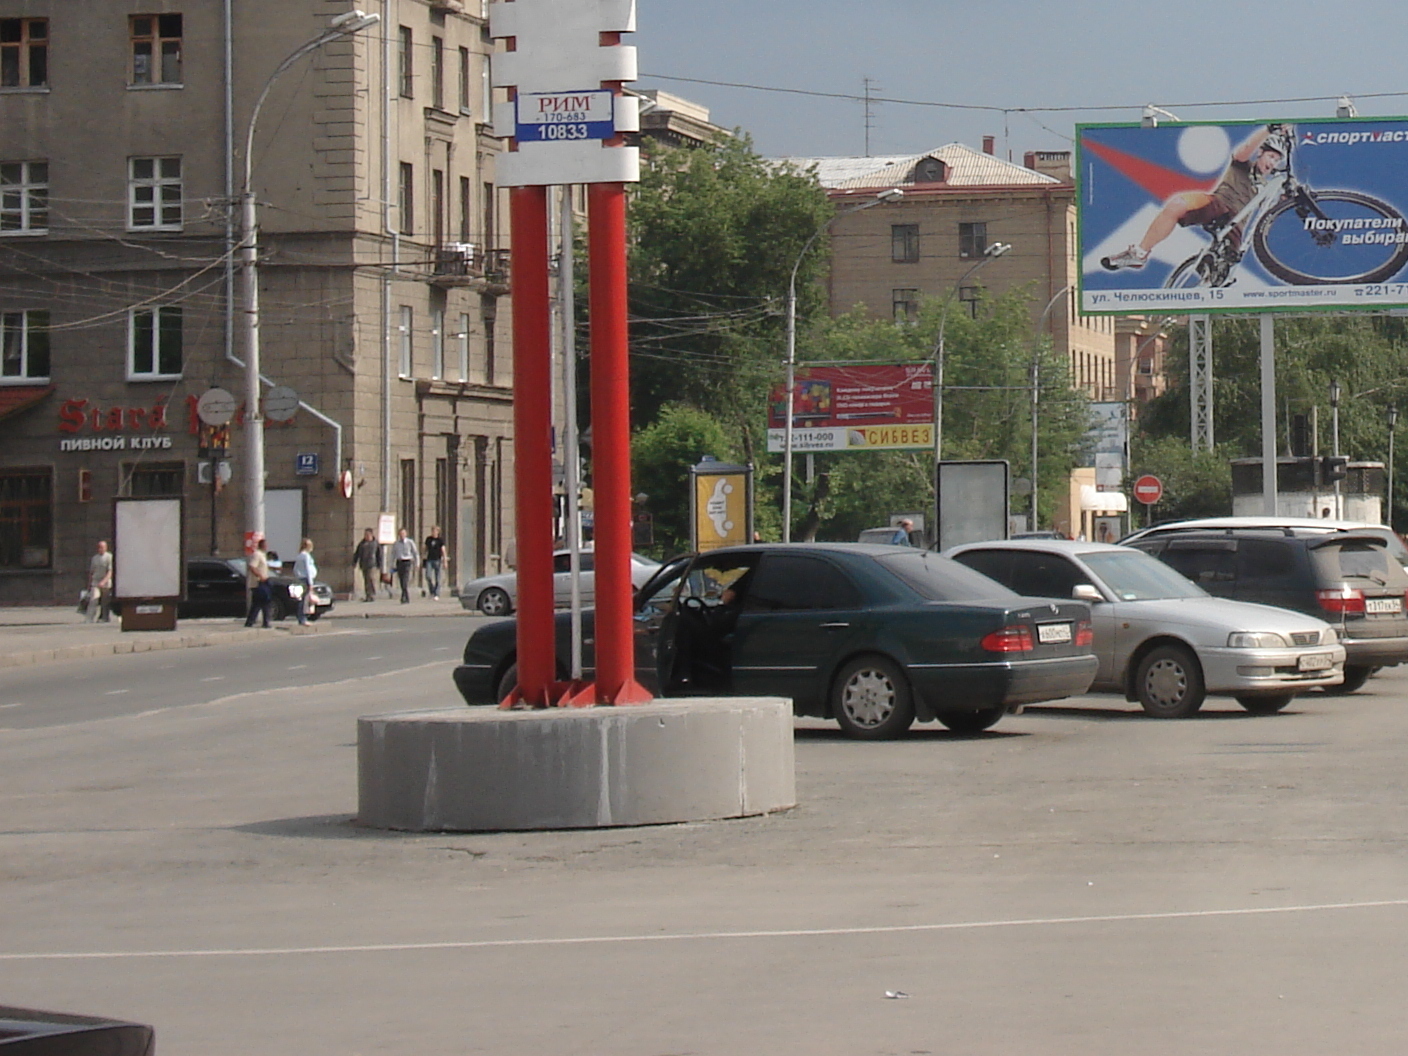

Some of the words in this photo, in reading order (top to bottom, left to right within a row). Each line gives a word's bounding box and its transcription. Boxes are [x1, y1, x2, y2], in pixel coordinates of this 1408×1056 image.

[538, 95, 591, 113] РИМ
[537, 124, 588, 140] 10833
[1303, 215, 1403, 233] Покупатели
[1091, 293, 1111, 304] ул.
[1210, 289, 1224, 300] 15
[1242, 288, 1337, 299] www.sportmaster.ru
[60, 435, 126, 452] ПИВНОЙ
[130, 436, 172, 450] КЛУБ
[301, 455, 314, 466] 12
